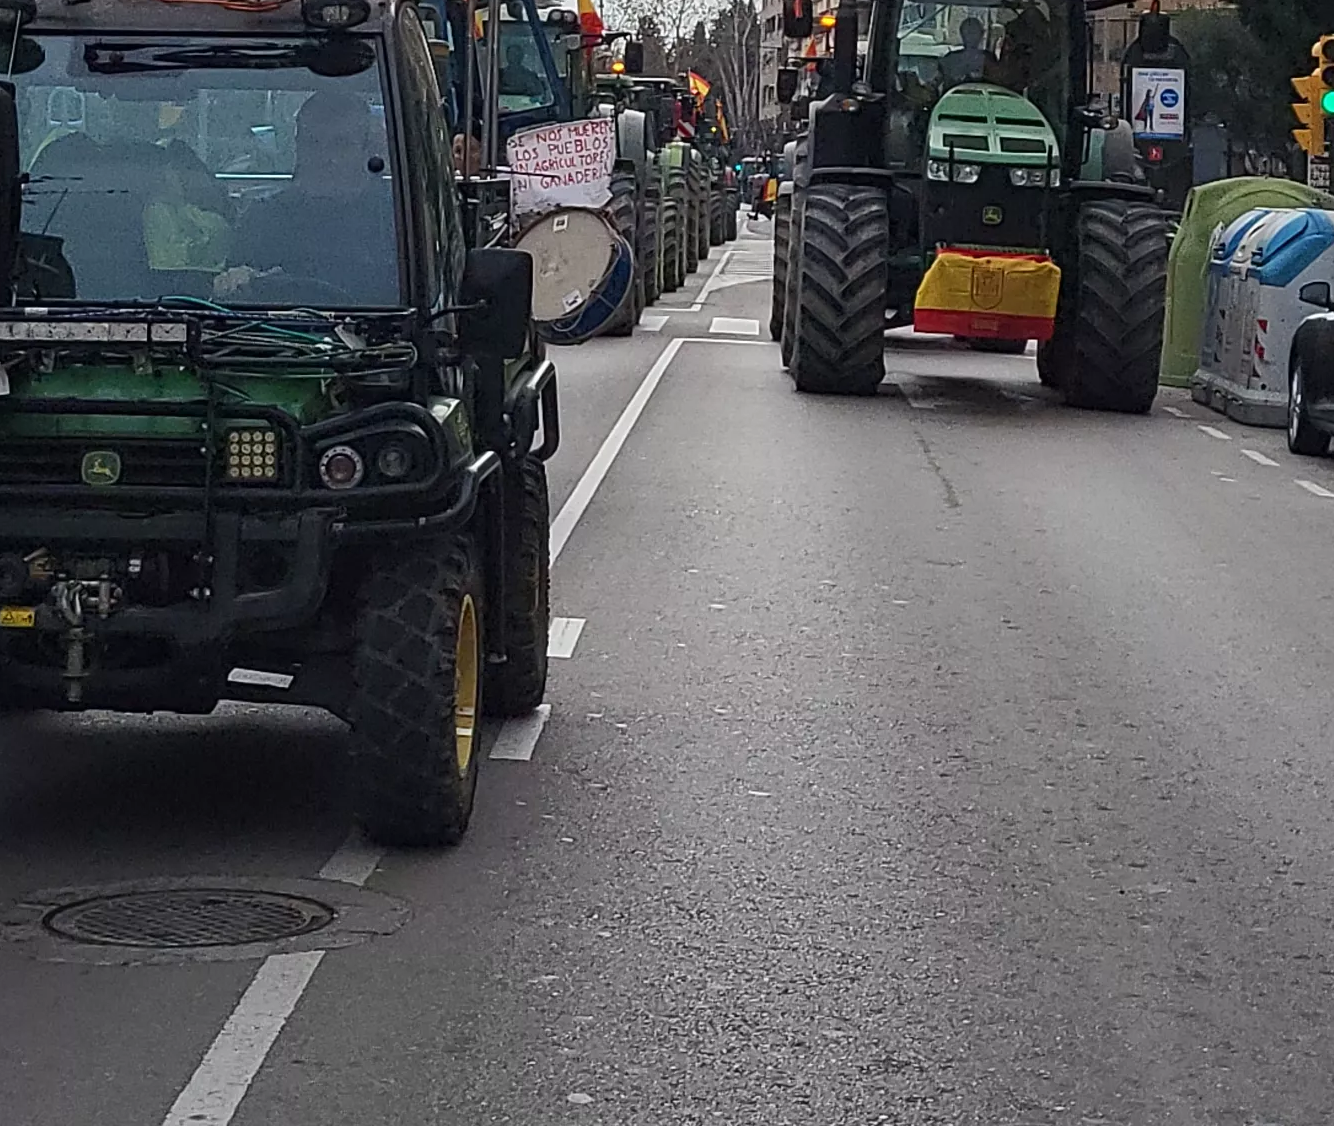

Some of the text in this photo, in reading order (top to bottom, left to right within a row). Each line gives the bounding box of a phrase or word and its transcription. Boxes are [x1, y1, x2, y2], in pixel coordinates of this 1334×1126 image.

[536, 129, 563, 144] NOS
[515, 136, 608, 162] LOS PUEBLOS
